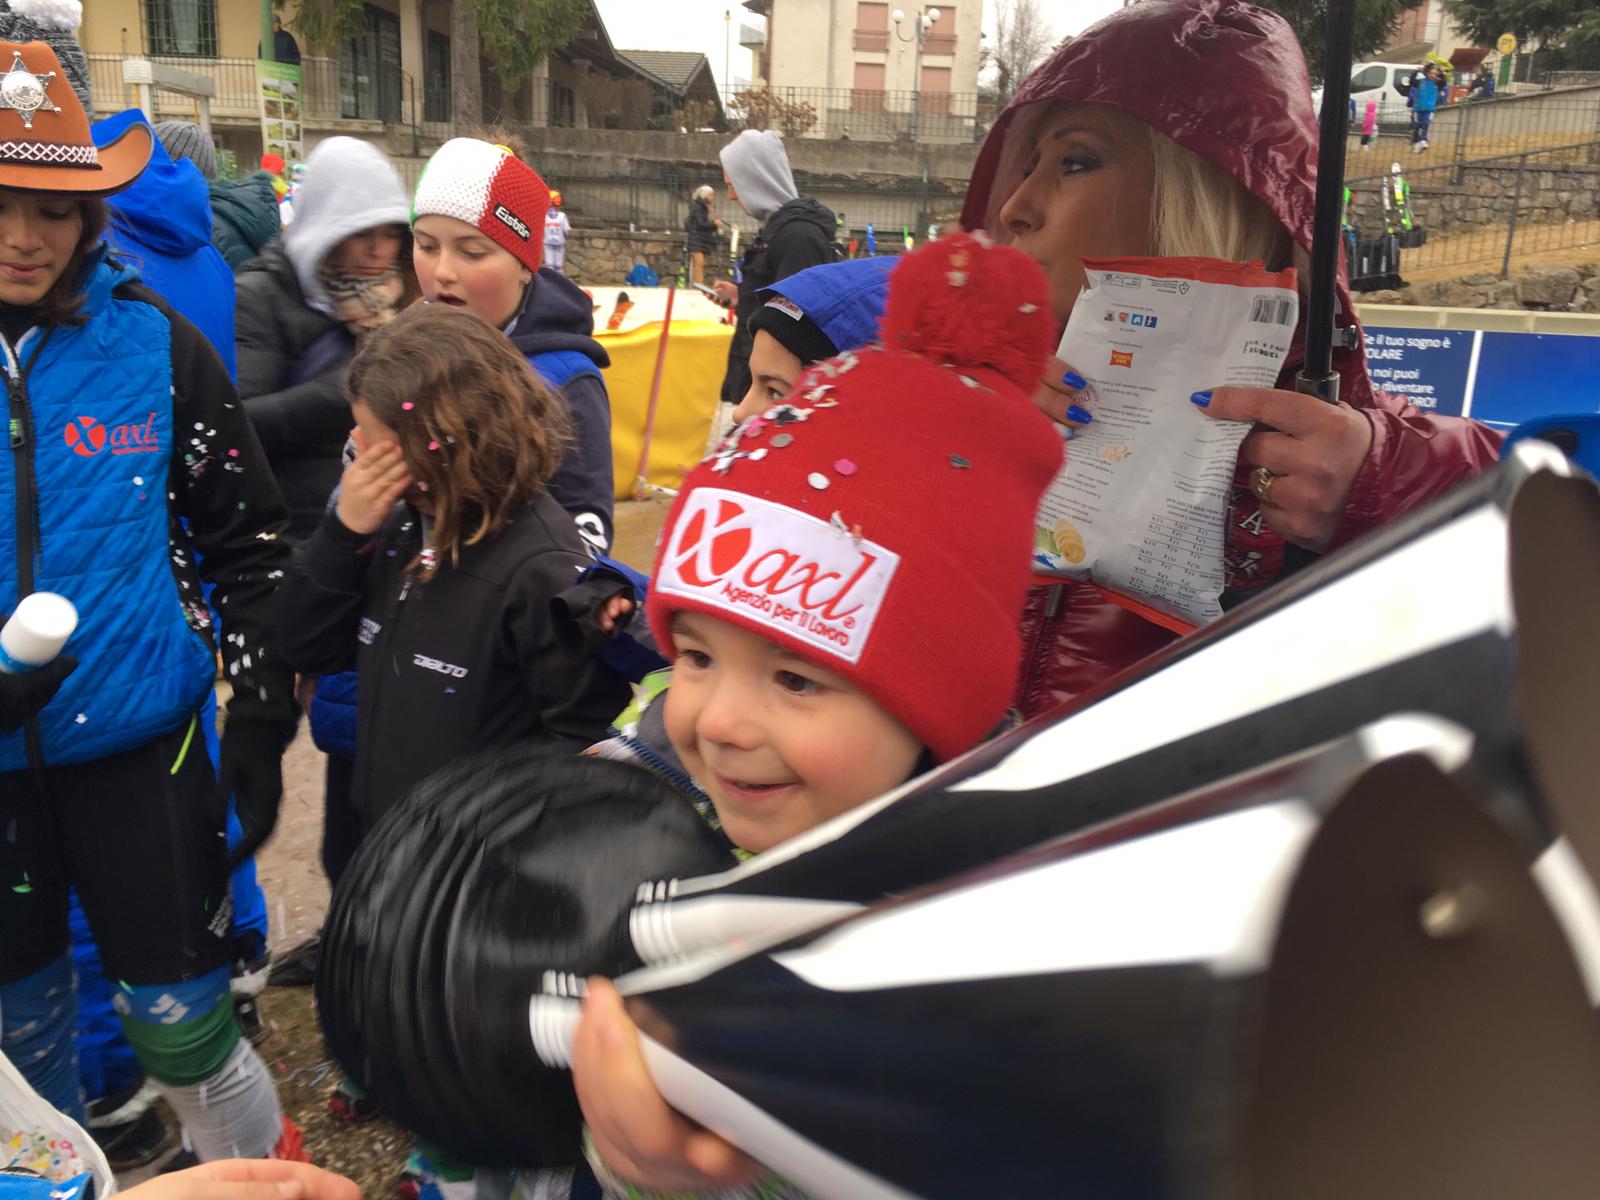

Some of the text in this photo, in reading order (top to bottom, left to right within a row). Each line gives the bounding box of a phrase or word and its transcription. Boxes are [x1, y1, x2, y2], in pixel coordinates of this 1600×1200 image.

[1376, 334, 1385, 346] il
[1385, 336, 1406, 347] tuo
[1406, 337, 1442, 350] sogno
[1442, 336, 1452, 349] è
[1373, 367, 1393, 379] noi
[1393, 368, 1421, 382] puoi
[1381, 381, 1435, 395] diventare
[1408, 396, 1438, 409] ORO!
[742, 547, 876, 621] axl
[719, 580, 772, 614] Agenzia
[772, 603, 800, 623] per
[807, 614, 850, 647] Lavoro
